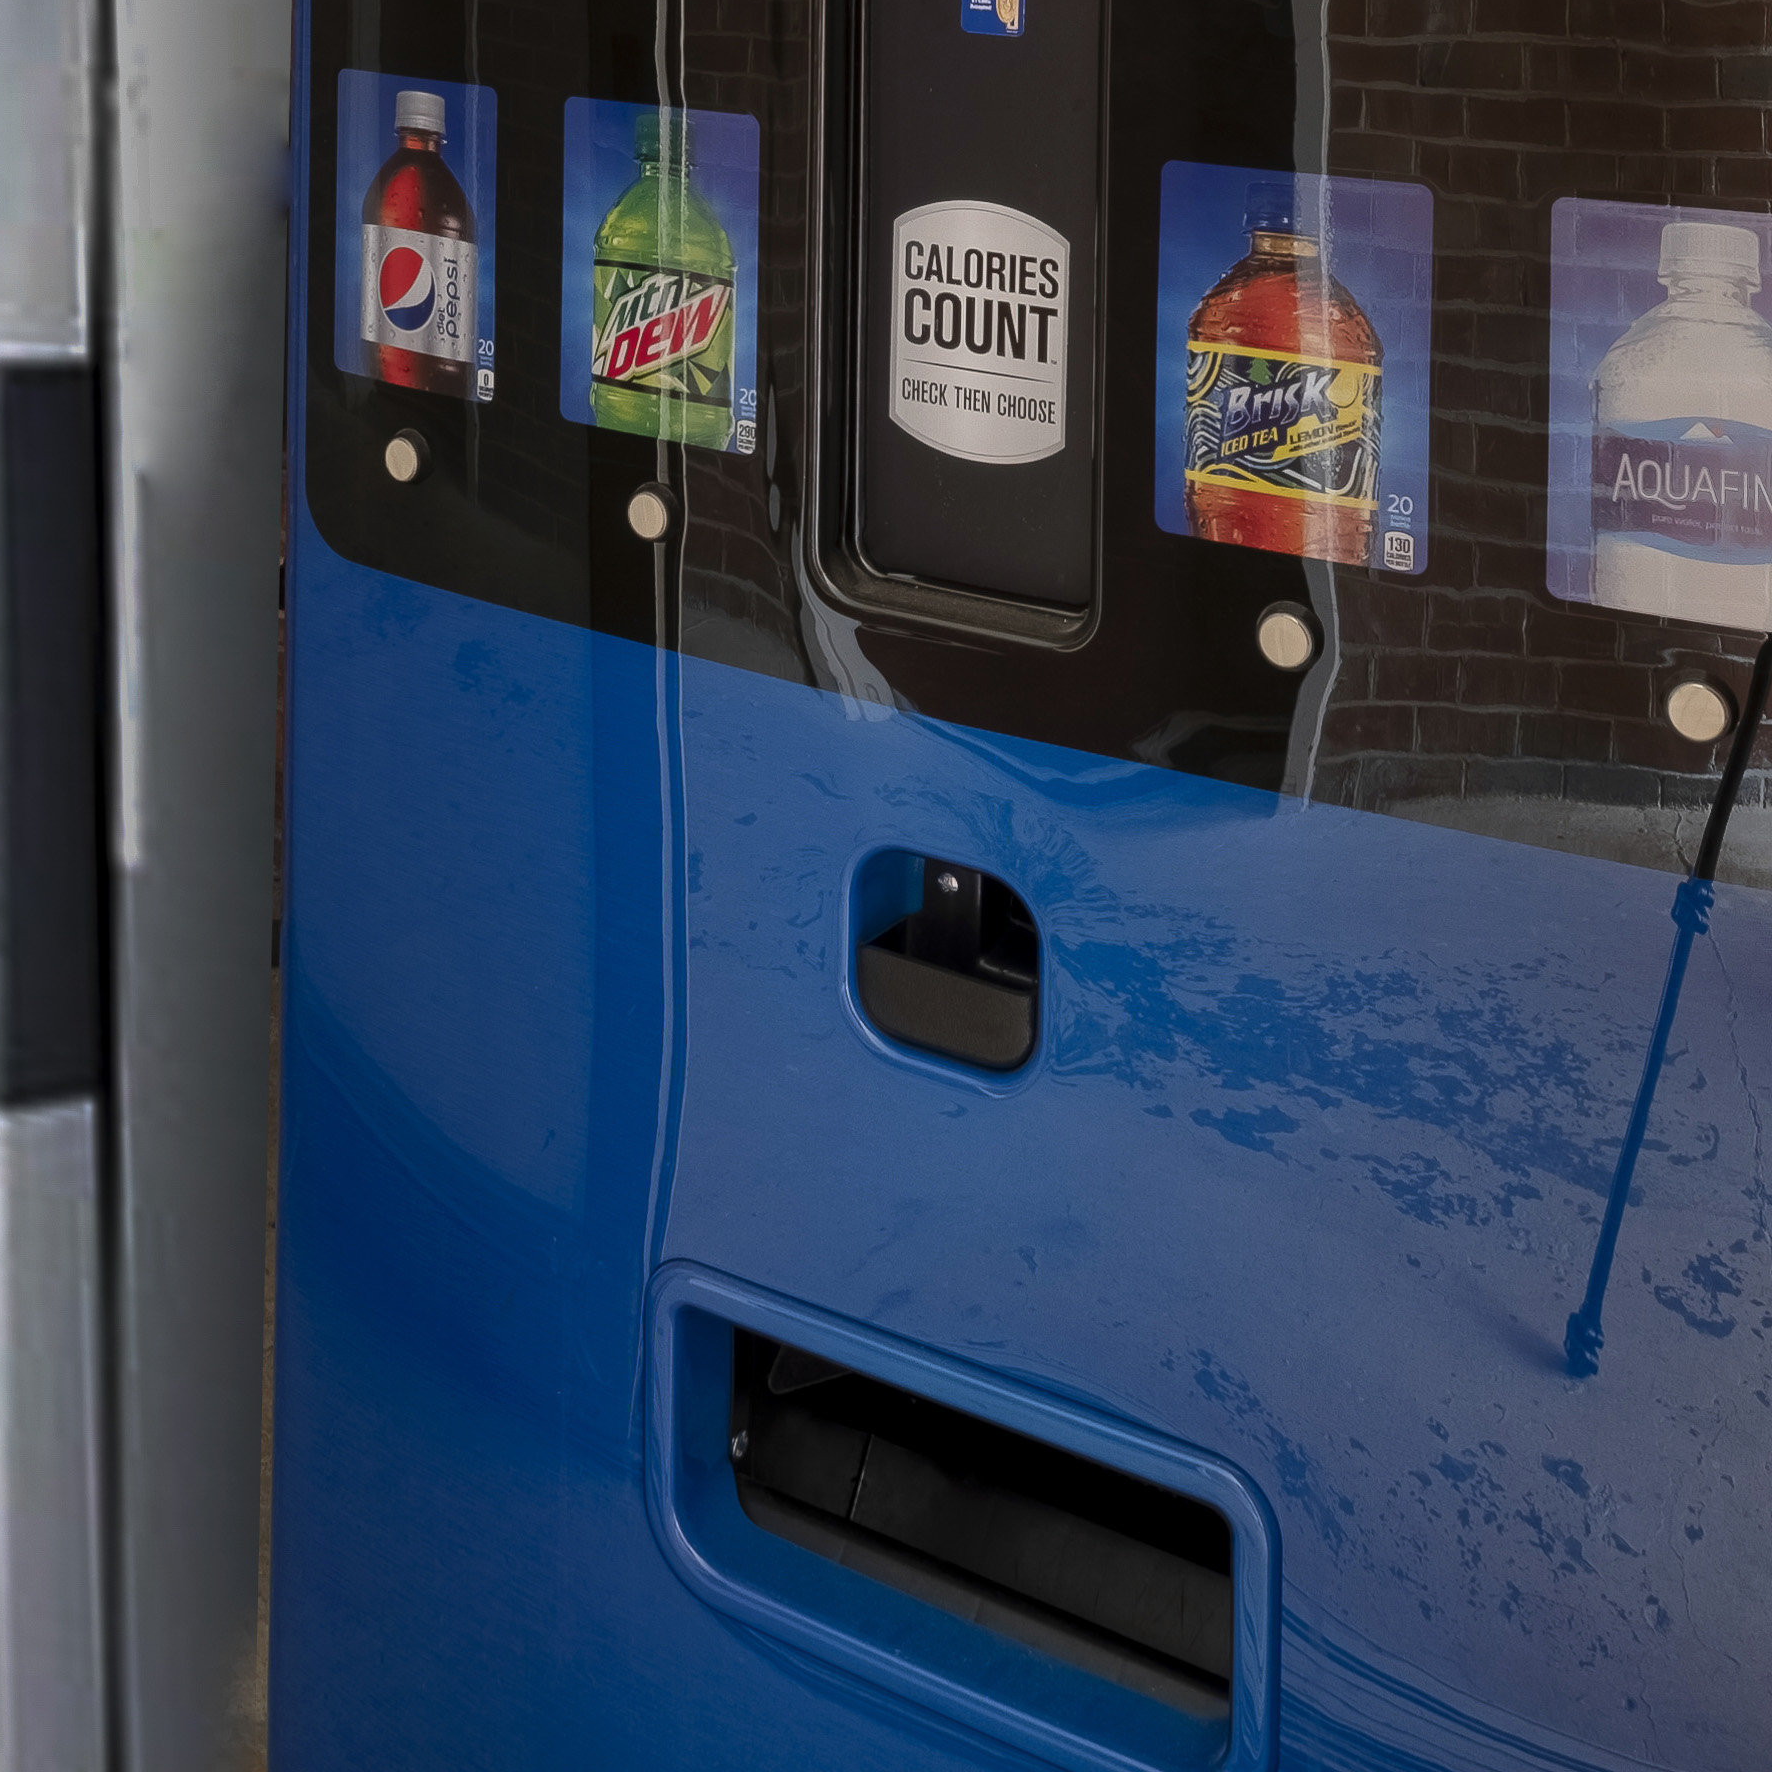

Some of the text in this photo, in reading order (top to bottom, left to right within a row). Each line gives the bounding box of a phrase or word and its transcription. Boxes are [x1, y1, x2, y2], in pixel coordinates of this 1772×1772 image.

[904, 239, 1060, 300] CALORIES
[443, 257, 461, 339] pepsi
[615, 279, 683, 333] Mtn
[437, 307, 446, 335] diet
[904, 287, 1059, 364] COUNT
[478, 338, 495, 357] 20
[483, 373, 489, 387] 0
[739, 387, 757, 406] 20
[902, 376, 1057, 425] CHECK THEN CHOOSE
[1221, 434, 1249, 458] ICED
[1251, 426, 1279, 448] TEA
[1289, 423, 1334, 445] LEMON
[1388, 493, 1414, 515] 20
[1388, 536, 1411, 554] 130
